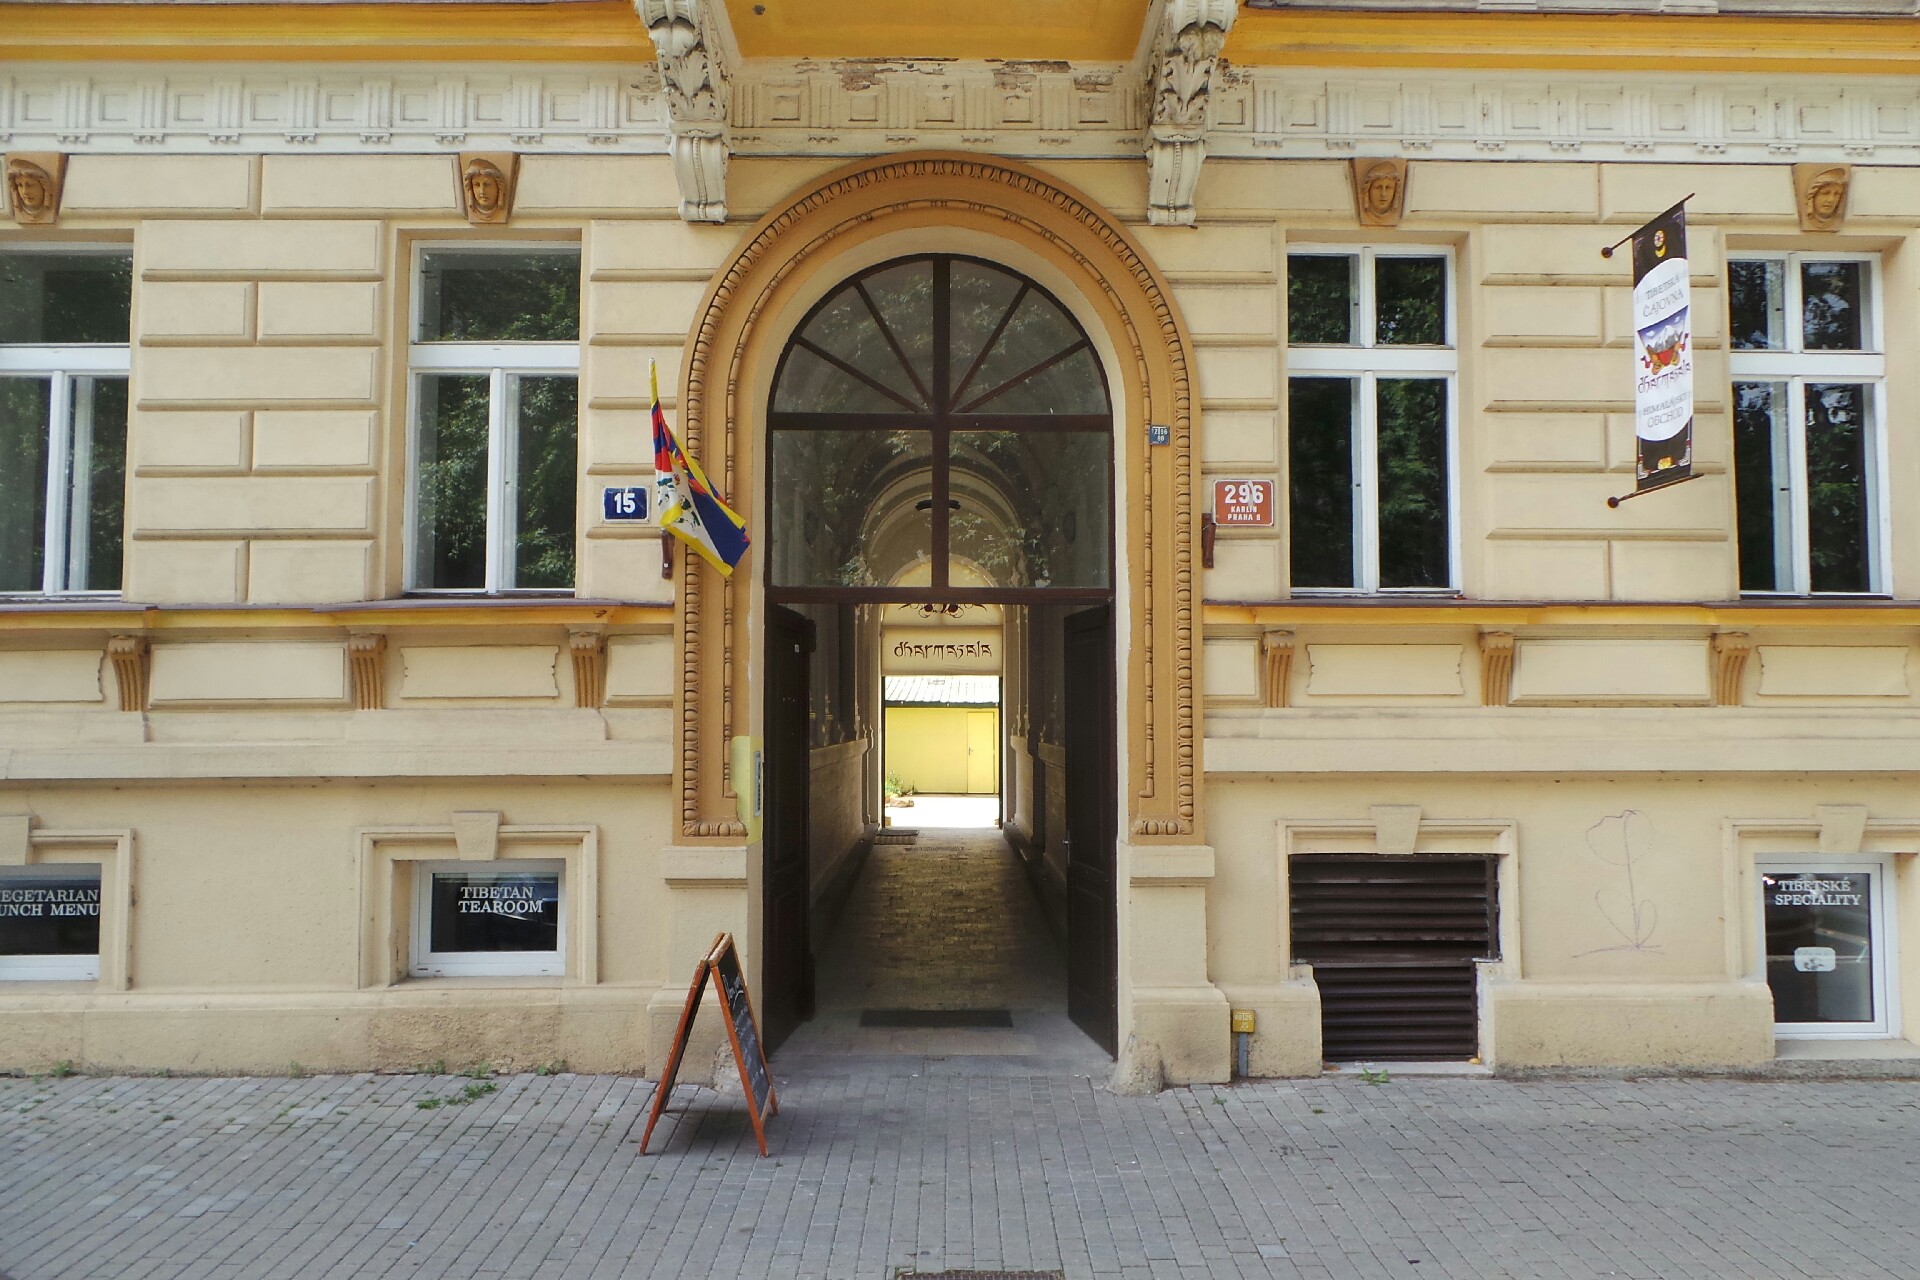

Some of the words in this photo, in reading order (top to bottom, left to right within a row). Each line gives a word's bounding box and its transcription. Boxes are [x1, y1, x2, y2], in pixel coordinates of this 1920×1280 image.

[1647, 406, 1684, 428] OBCHOD
[1224, 484, 1264, 504] 296
[614, 492, 636, 514] 15
[894, 641, 992, 660] dharmasala
[1778, 877, 1851, 892] TIBETSKÉ
[0, 889, 99, 902] EGETARIAN
[461, 886, 534, 899] TIBETAN
[458, 900, 544, 913] TEAROOM
[1775, 894, 1861, 906] SPECIALITY
[0, 903, 43, 916] UNCH
[50, 903, 100, 916] MENU
